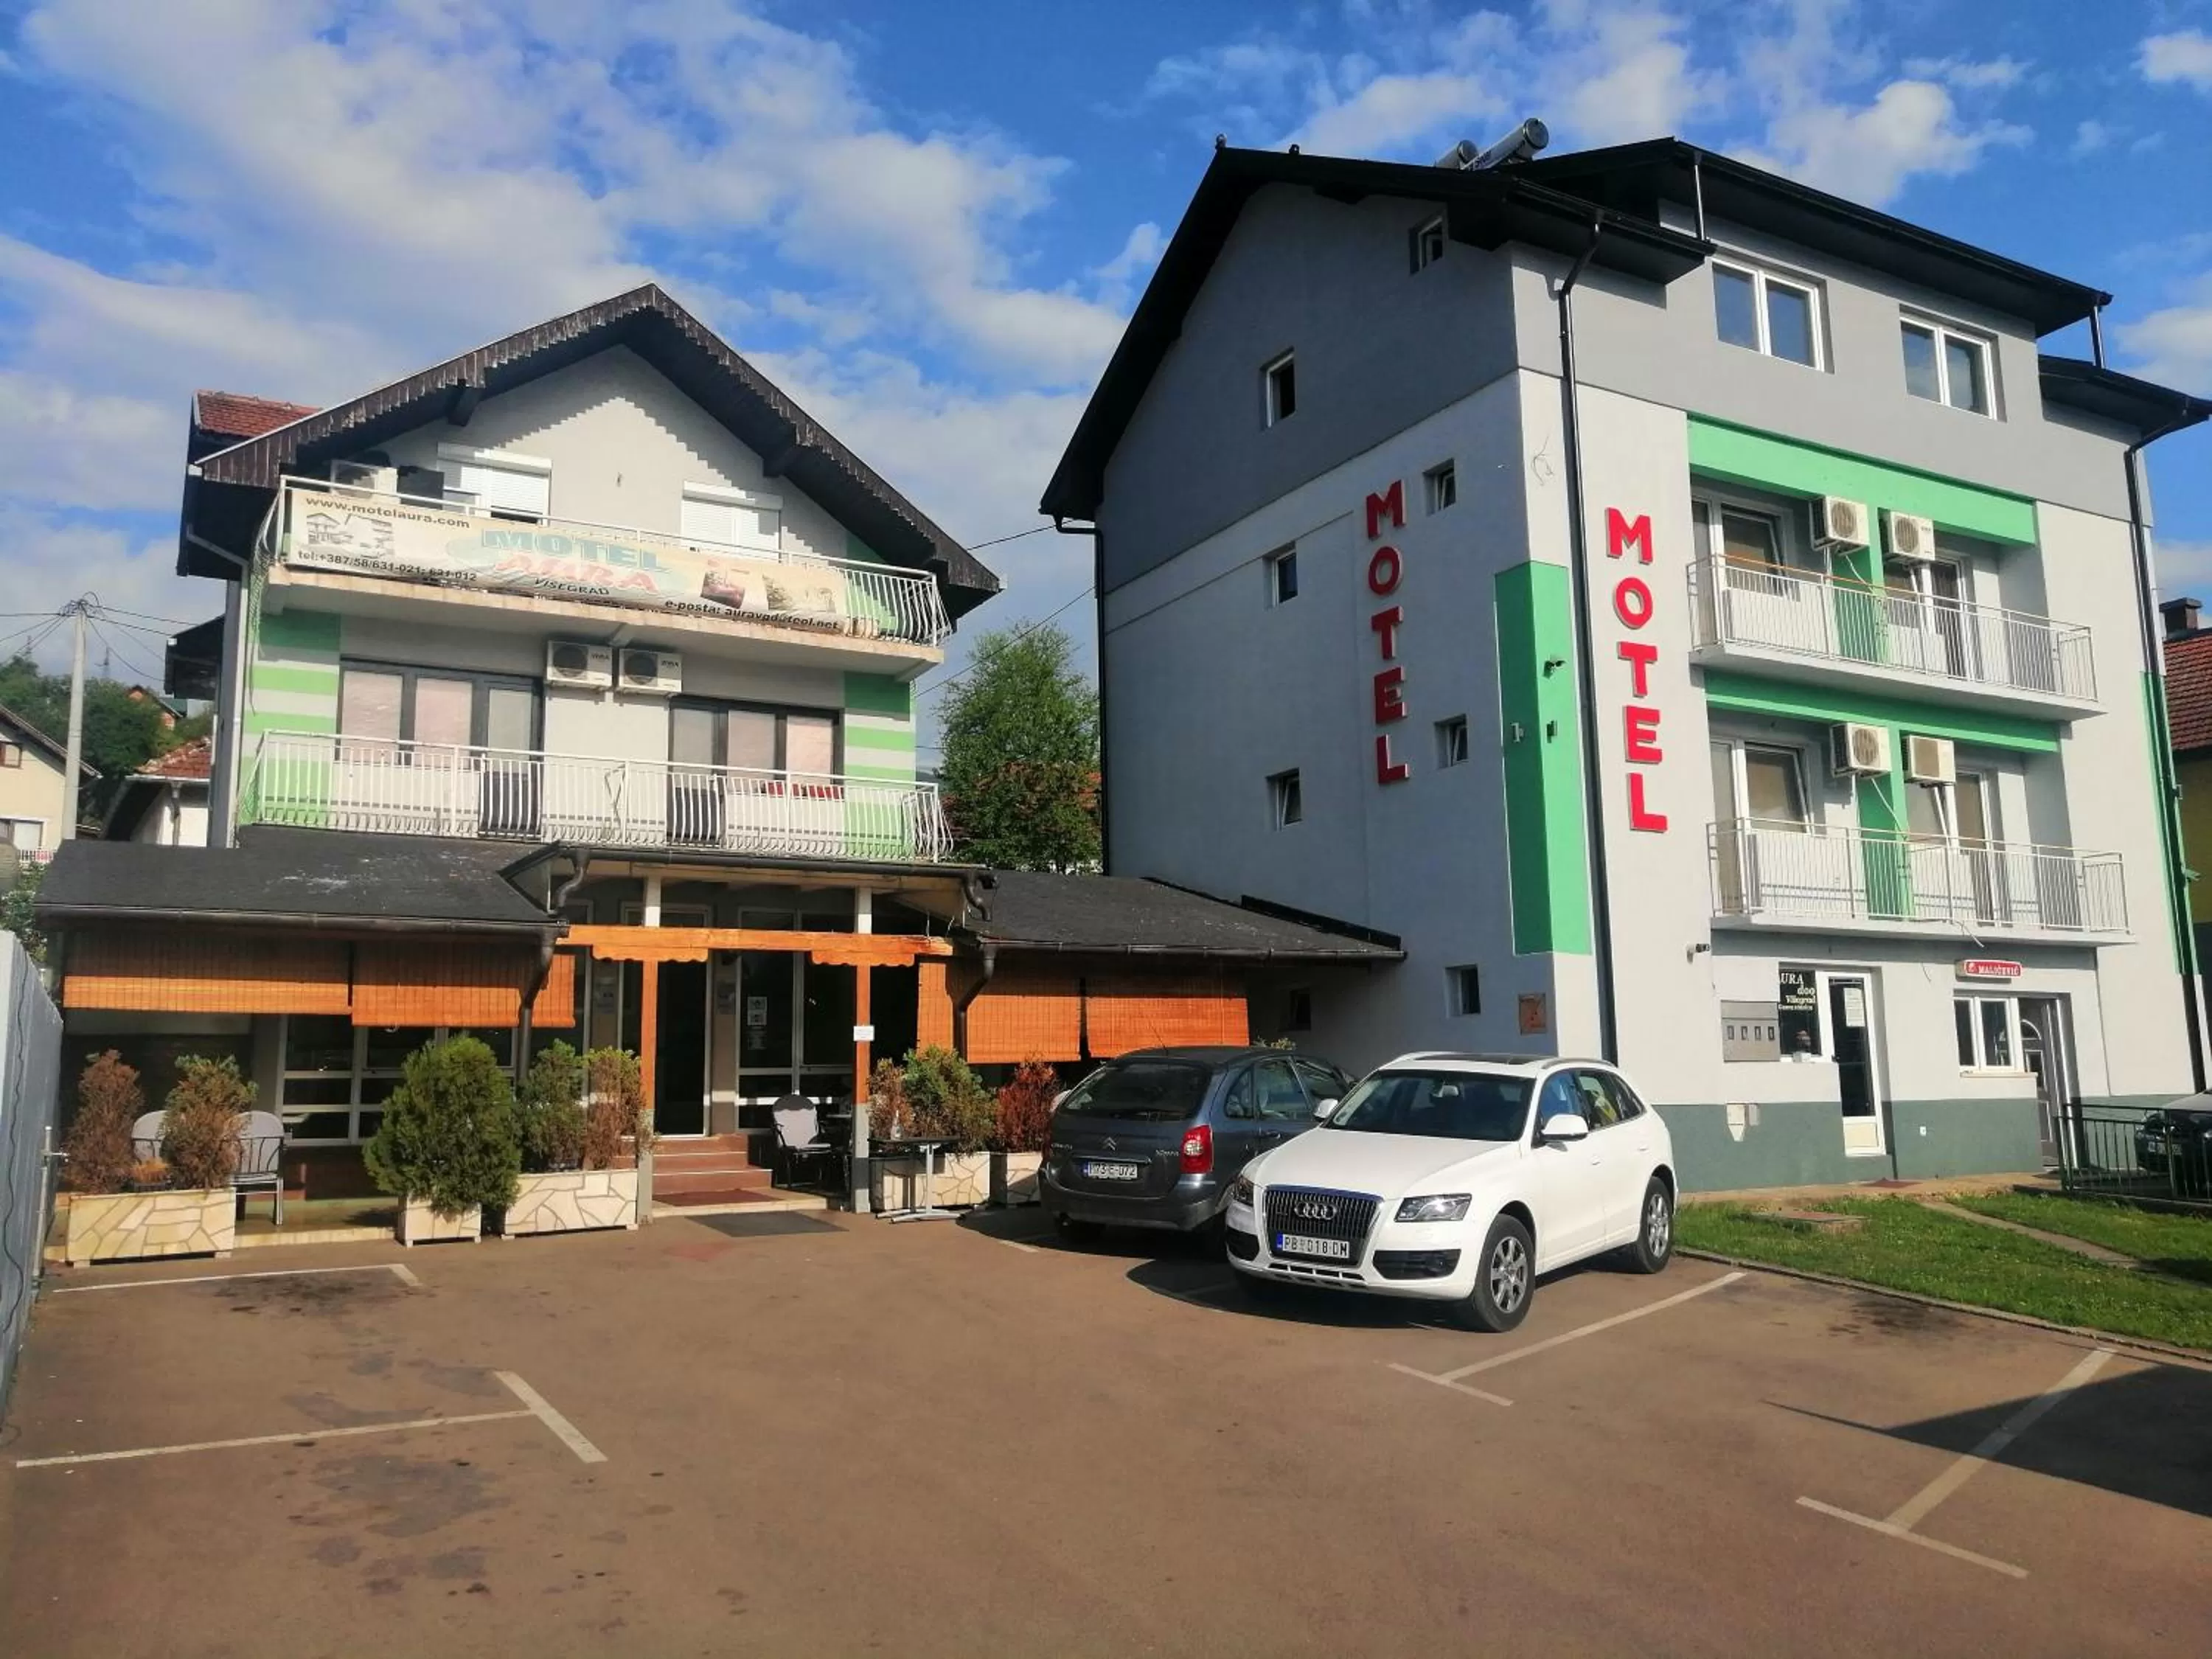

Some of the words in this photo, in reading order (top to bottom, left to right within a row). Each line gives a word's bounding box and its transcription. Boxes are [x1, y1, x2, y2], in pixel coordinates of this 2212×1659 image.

[306, 497, 470, 529] www.motelaura.com
[482, 529, 658, 569] MOTEL
[495, 554, 659, 593] AURA
[1366, 479, 1410, 785] MOTEL
[1604, 507, 1668, 833] MOTEL
